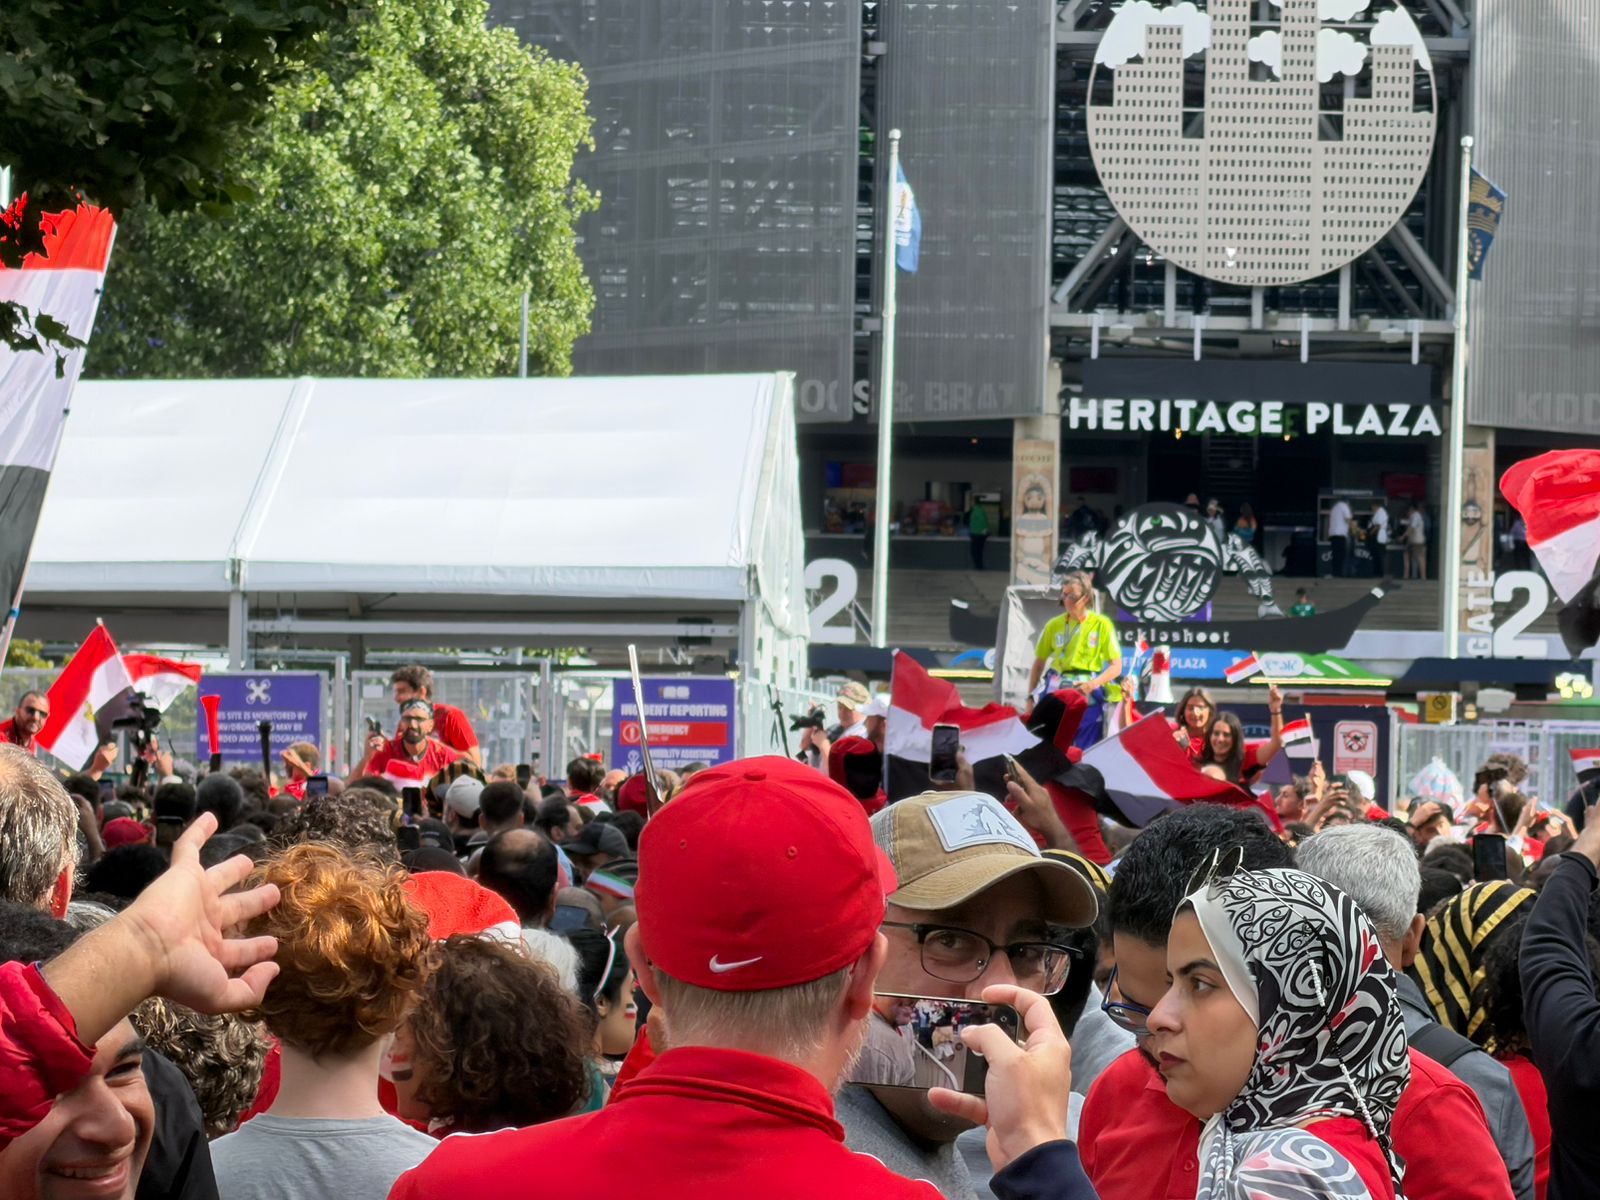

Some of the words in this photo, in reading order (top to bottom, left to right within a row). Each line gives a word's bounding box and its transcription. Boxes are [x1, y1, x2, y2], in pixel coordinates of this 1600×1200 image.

[1069, 397, 1284, 433] HERITAGE
[1306, 402, 1442, 437] PLAZA
[804, 558, 858, 644] 2
[1467, 571, 1495, 657] GATE
[1493, 570, 1549, 658] 2
[1170, 657, 1207, 669] PLAZA
[621, 704, 668, 716] INCDENT
